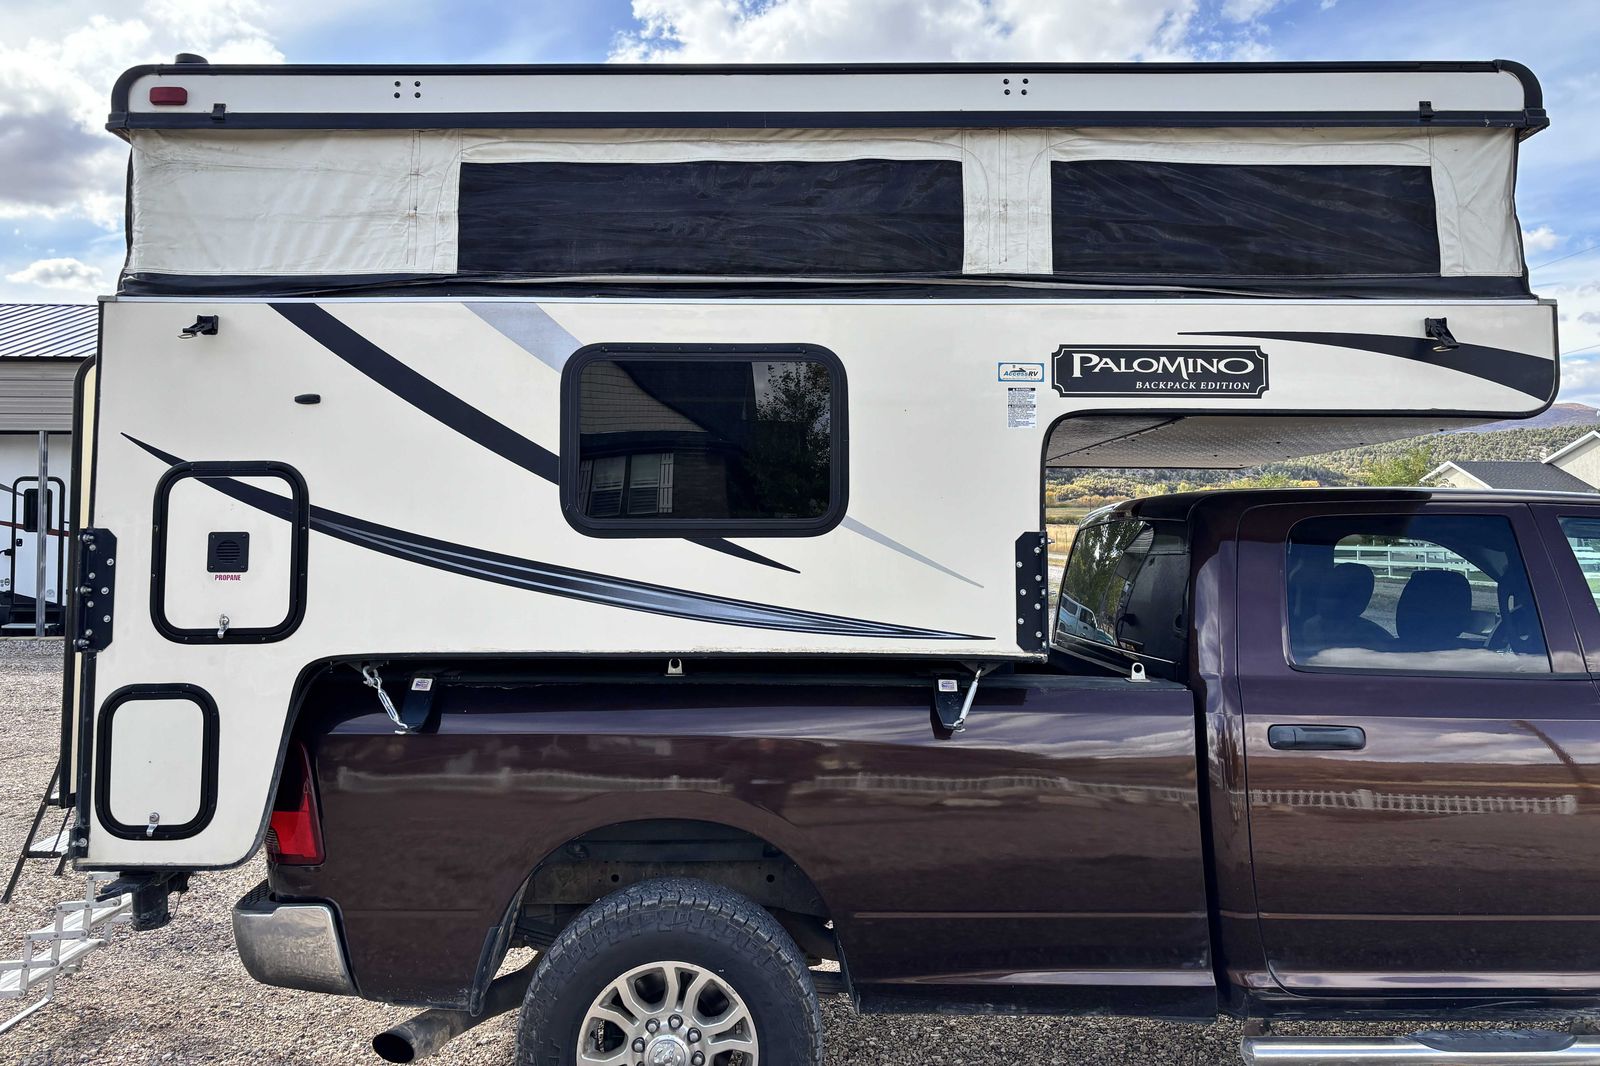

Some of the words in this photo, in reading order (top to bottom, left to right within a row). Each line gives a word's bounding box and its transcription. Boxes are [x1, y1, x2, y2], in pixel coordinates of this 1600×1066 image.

[1071, 353, 1255, 380] PALOMINO
[1135, 381, 1197, 390] BACKPACK
[1200, 381, 1251, 390] EDITION
